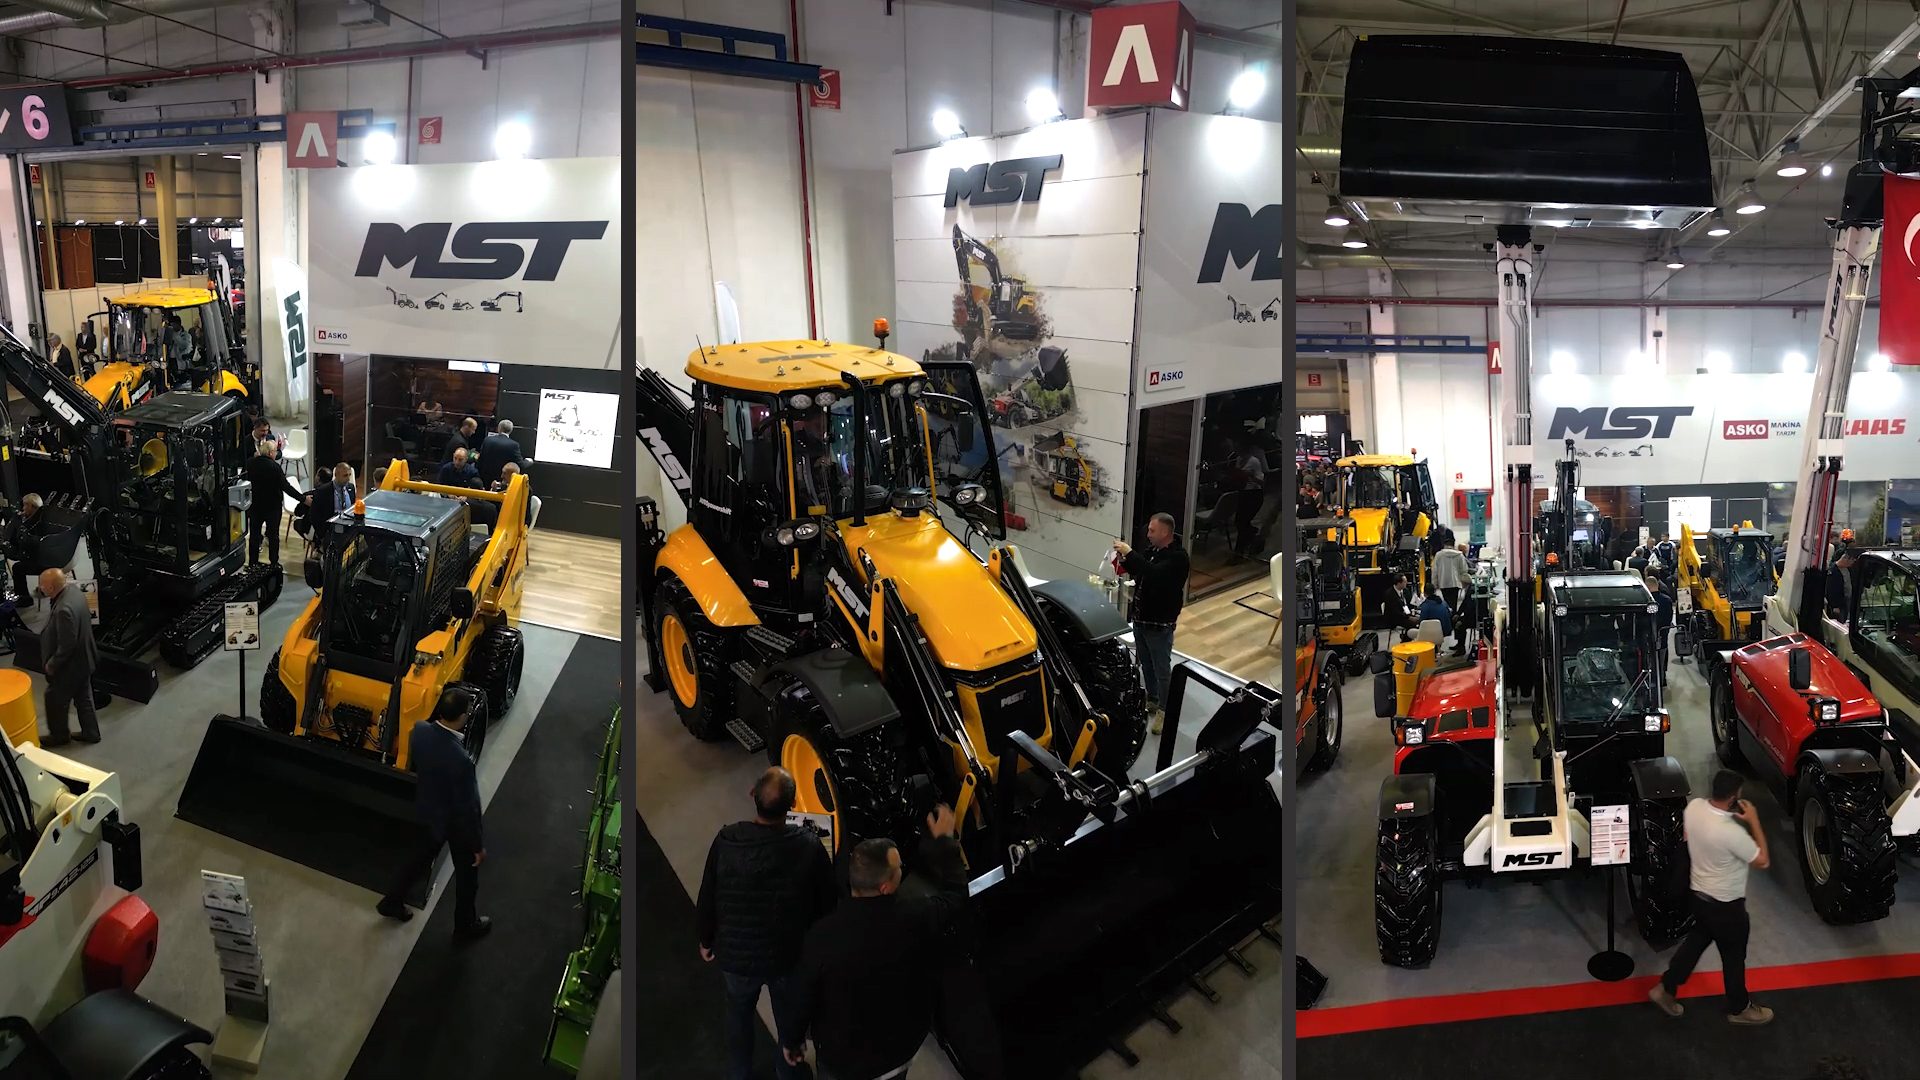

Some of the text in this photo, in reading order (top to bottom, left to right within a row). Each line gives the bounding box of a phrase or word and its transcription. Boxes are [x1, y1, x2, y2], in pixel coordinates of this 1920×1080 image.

[22, 94, 49, 140] 6
[944, 154, 1063, 207] MST
[354, 221, 609, 281] MST
[284, 290, 307, 379] MST
[1161, 370, 1184, 382] ASKO
[43, 389, 85, 426] MST
[1547, 406, 1694, 440] MST
[1725, 424, 1767, 436] ASKO
[639, 427, 691, 490] MST
[826, 567, 870, 618] MST
[1001, 690, 1027, 709] MST
[1503, 851, 1563, 867] MST
